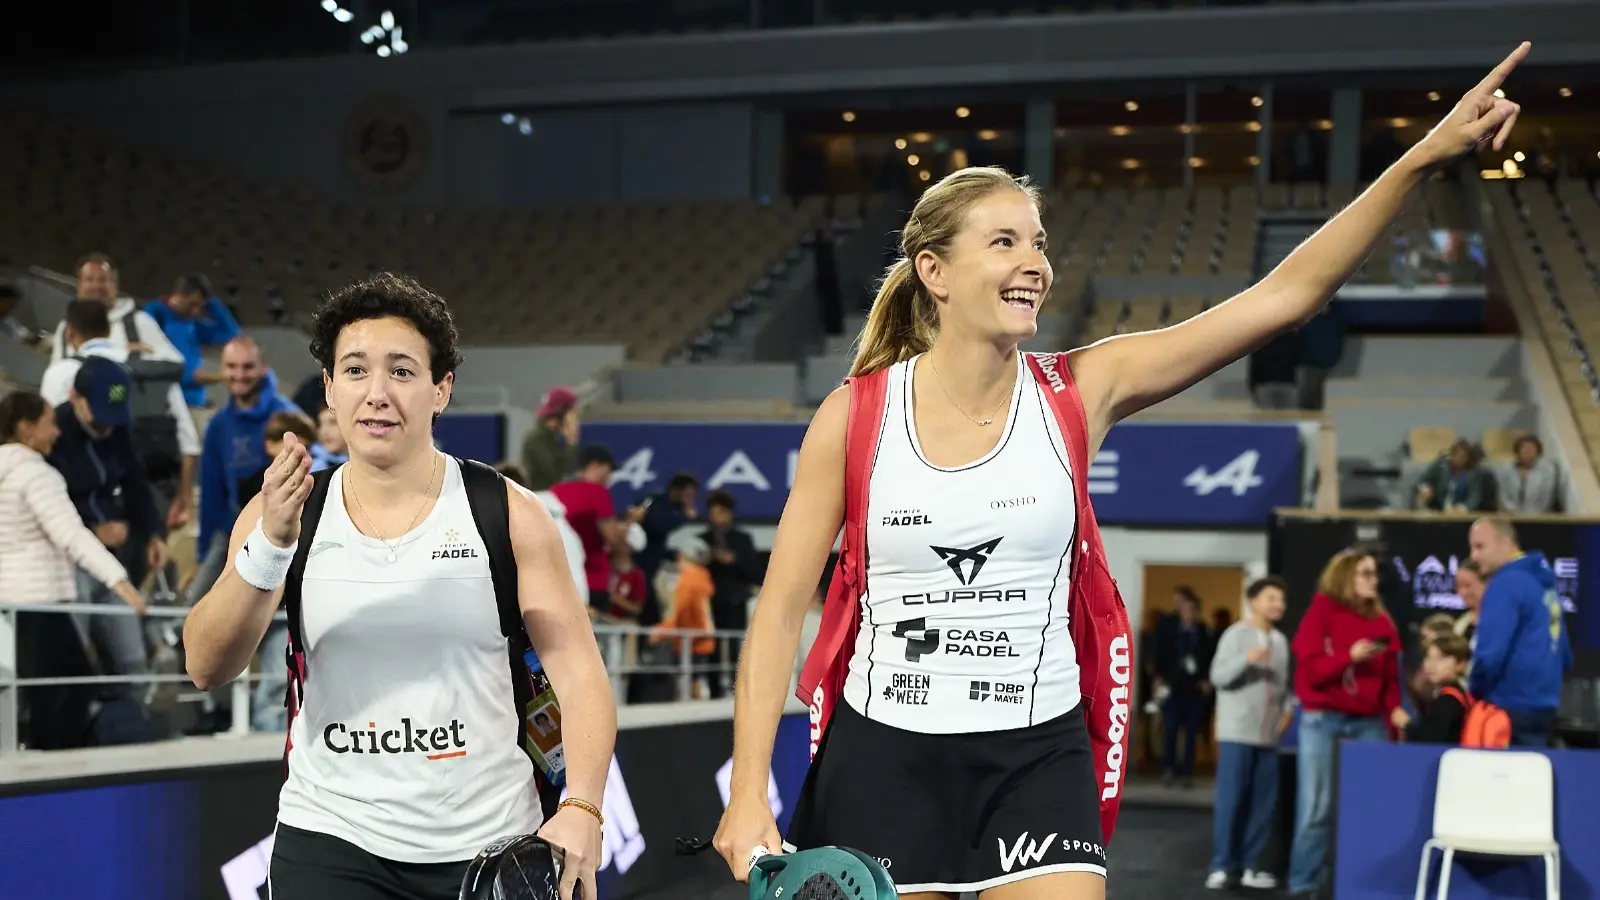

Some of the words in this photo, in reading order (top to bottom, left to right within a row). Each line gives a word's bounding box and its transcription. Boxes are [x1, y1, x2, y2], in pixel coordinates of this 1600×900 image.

[990, 496, 1036, 510] OYSHO
[882, 515, 933, 527] PADEL
[431, 549, 479, 560] PADEL
[902, 589, 1027, 606] CUPRA
[946, 629, 1011, 643] CASA
[945, 643, 1021, 657] PADEL
[892, 673, 930, 690] GREEN
[994, 682, 1025, 694] DBP
[896, 689, 929, 705] WEEZ
[994, 694, 1024, 705] MAYET
[1101, 632, 1130, 801] Wilson
[323, 718, 467, 755] Cricket
